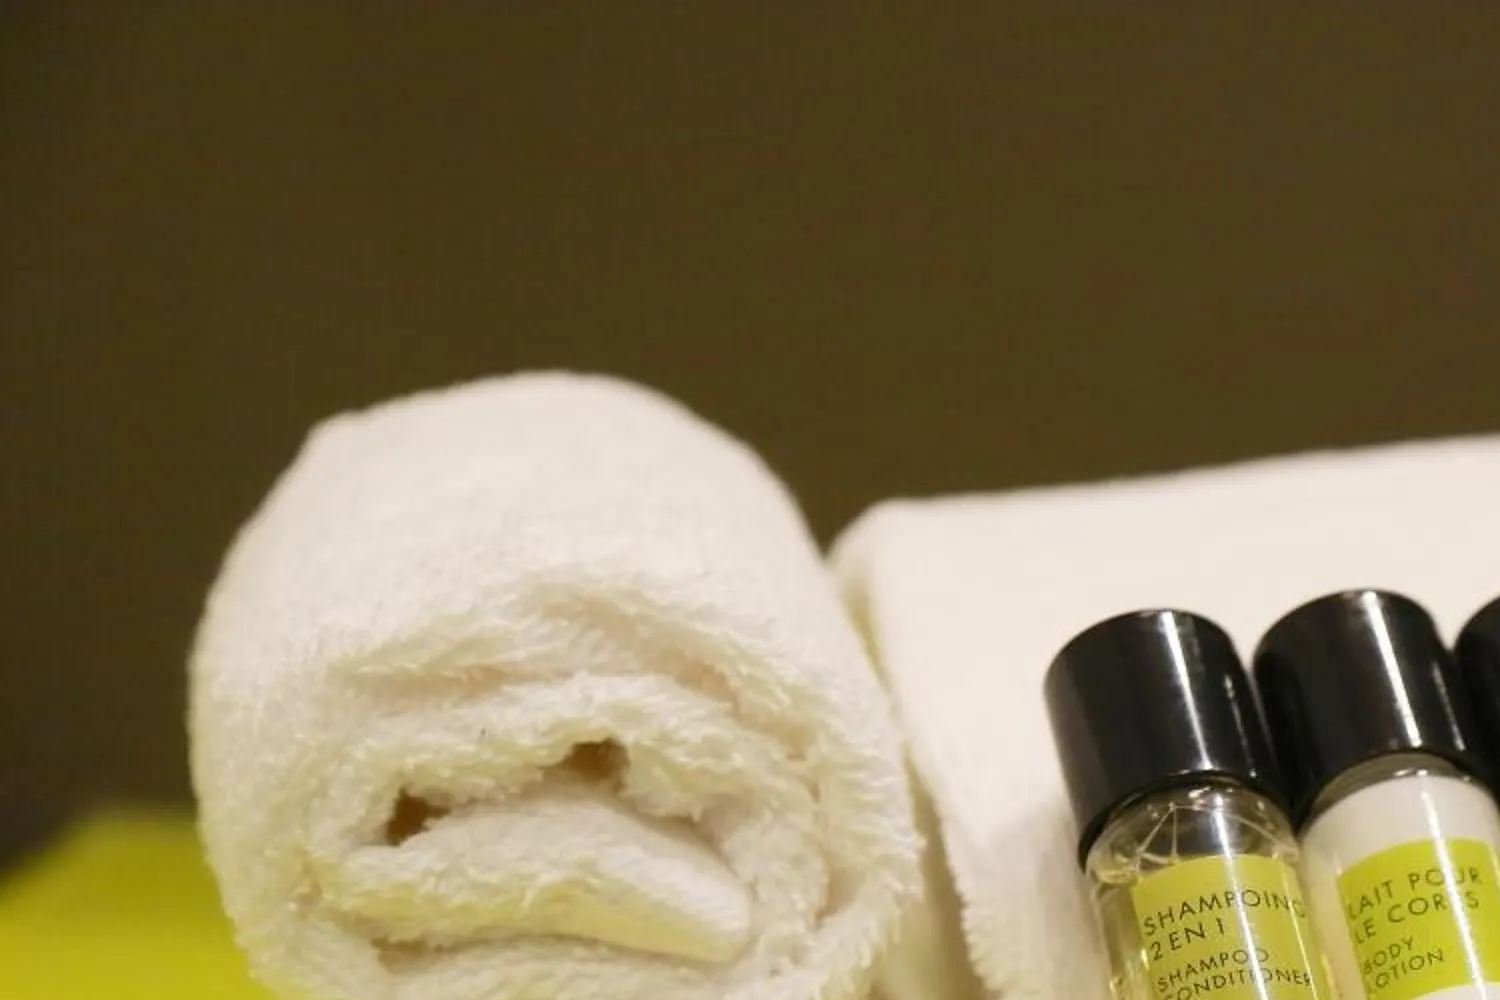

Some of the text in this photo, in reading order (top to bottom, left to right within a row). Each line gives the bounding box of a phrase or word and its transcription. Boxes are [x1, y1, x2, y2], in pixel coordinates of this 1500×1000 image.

[1143, 889, 1306, 937] SHAMPOING
[1347, 866, 1482, 921] LAIT POUR
[1354, 890, 1480, 945] LE CORS
[1150, 940, 1164, 961] 2
[1169, 923, 1205, 952] EN
[1363, 935, 1414, 976] BODY
[1156, 947, 1270, 993] SHAMPOO
